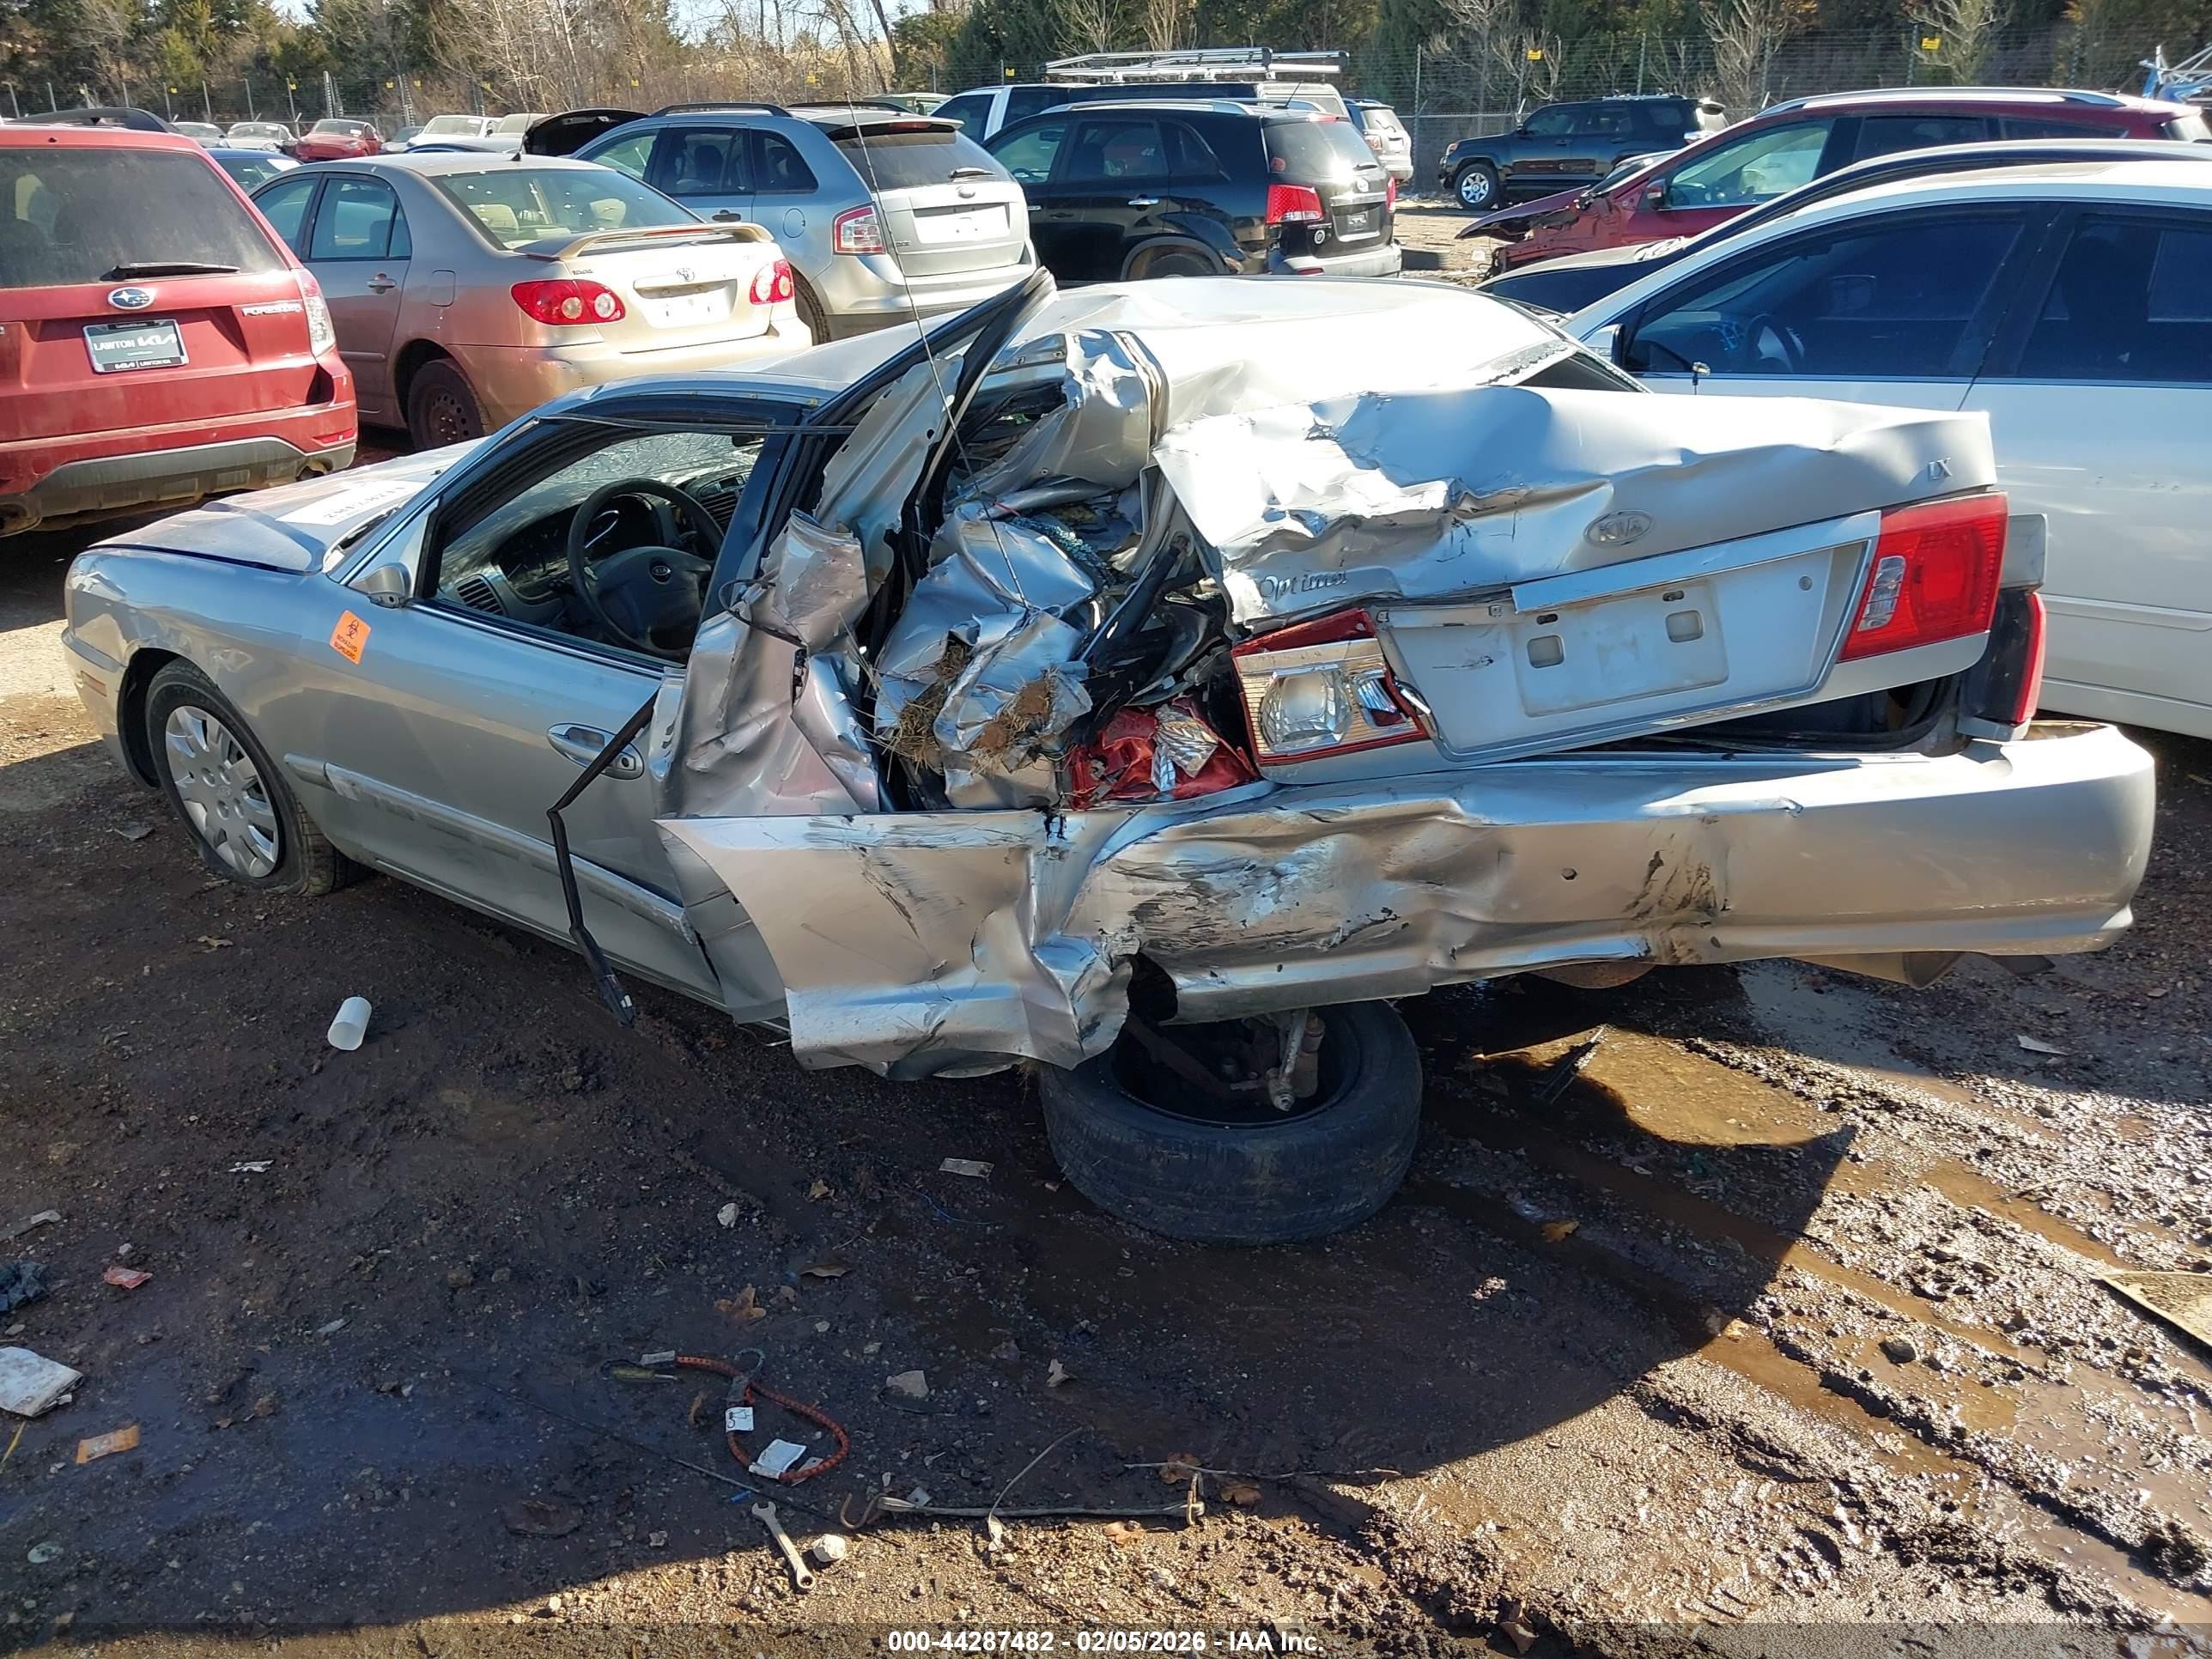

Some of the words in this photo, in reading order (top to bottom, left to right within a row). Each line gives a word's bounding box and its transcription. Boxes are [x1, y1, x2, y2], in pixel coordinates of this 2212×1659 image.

[93, 339, 136, 350] LAWTON
[1927, 457, 1953, 481] LX
[1598, 516, 1644, 542] KIA
[1259, 571, 1347, 601] Optima
